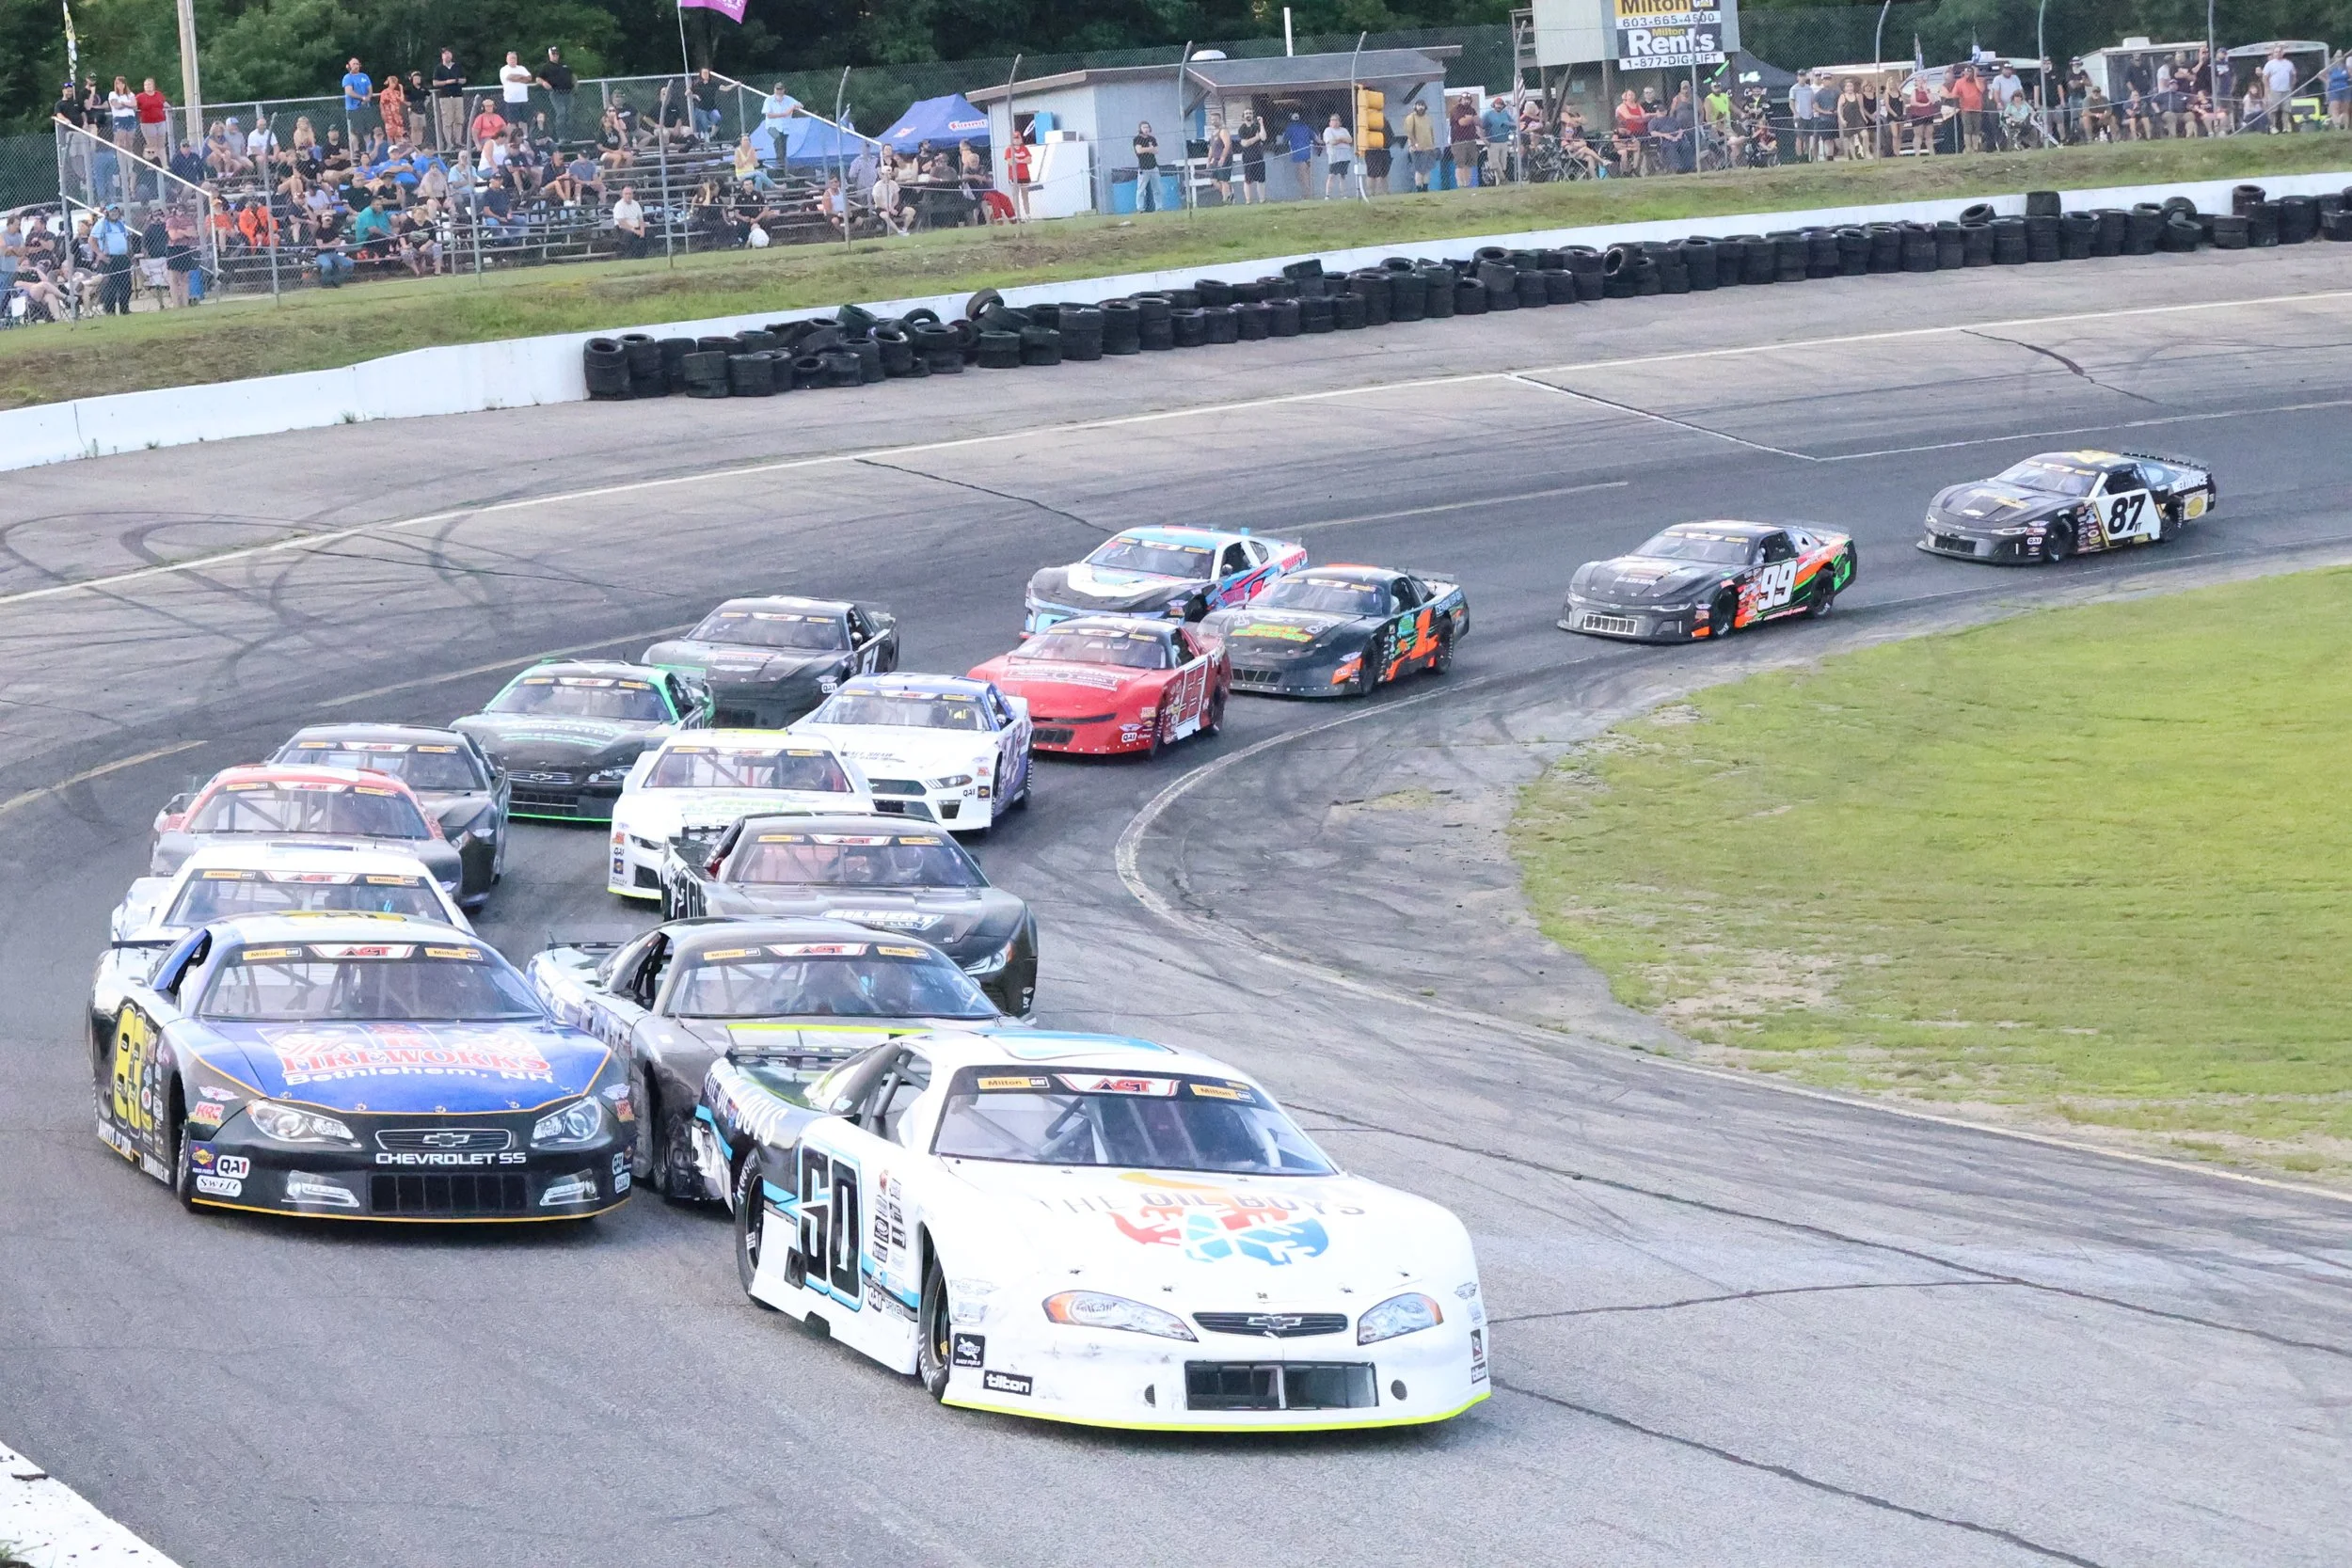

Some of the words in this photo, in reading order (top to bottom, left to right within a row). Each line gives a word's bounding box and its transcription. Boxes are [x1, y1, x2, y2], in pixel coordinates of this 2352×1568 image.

[1621, 0, 1688, 14] Milton
[1651, 26, 1685, 37] Milton
[1627, 27, 1715, 56] Rents
[1627, 53, 1718, 68] 1-877-DIG-LIFT
[2108, 494, 2146, 535] 87
[1756, 561, 1798, 611] 99
[281, 1048, 551, 1075] FIREWORKS
[281, 1066, 488, 1086] Bethlehem,
[501, 1069, 554, 1084] NH
[988, 1079, 1023, 1087] Milton
[1200, 1086, 1232, 1098] Milton
[219, 1158, 247, 1174] QA1
[375, 1152, 497, 1165] CHEVROLET
[500, 1152, 527, 1164] SS
[199, 1178, 239, 1191] Swift
[1038, 1192, 1127, 1213] THE
[1140, 1192, 1221, 1207] OIL
[1237, 1194, 1366, 1215] BOYS
[986, 1373, 1031, 1393] tilton
